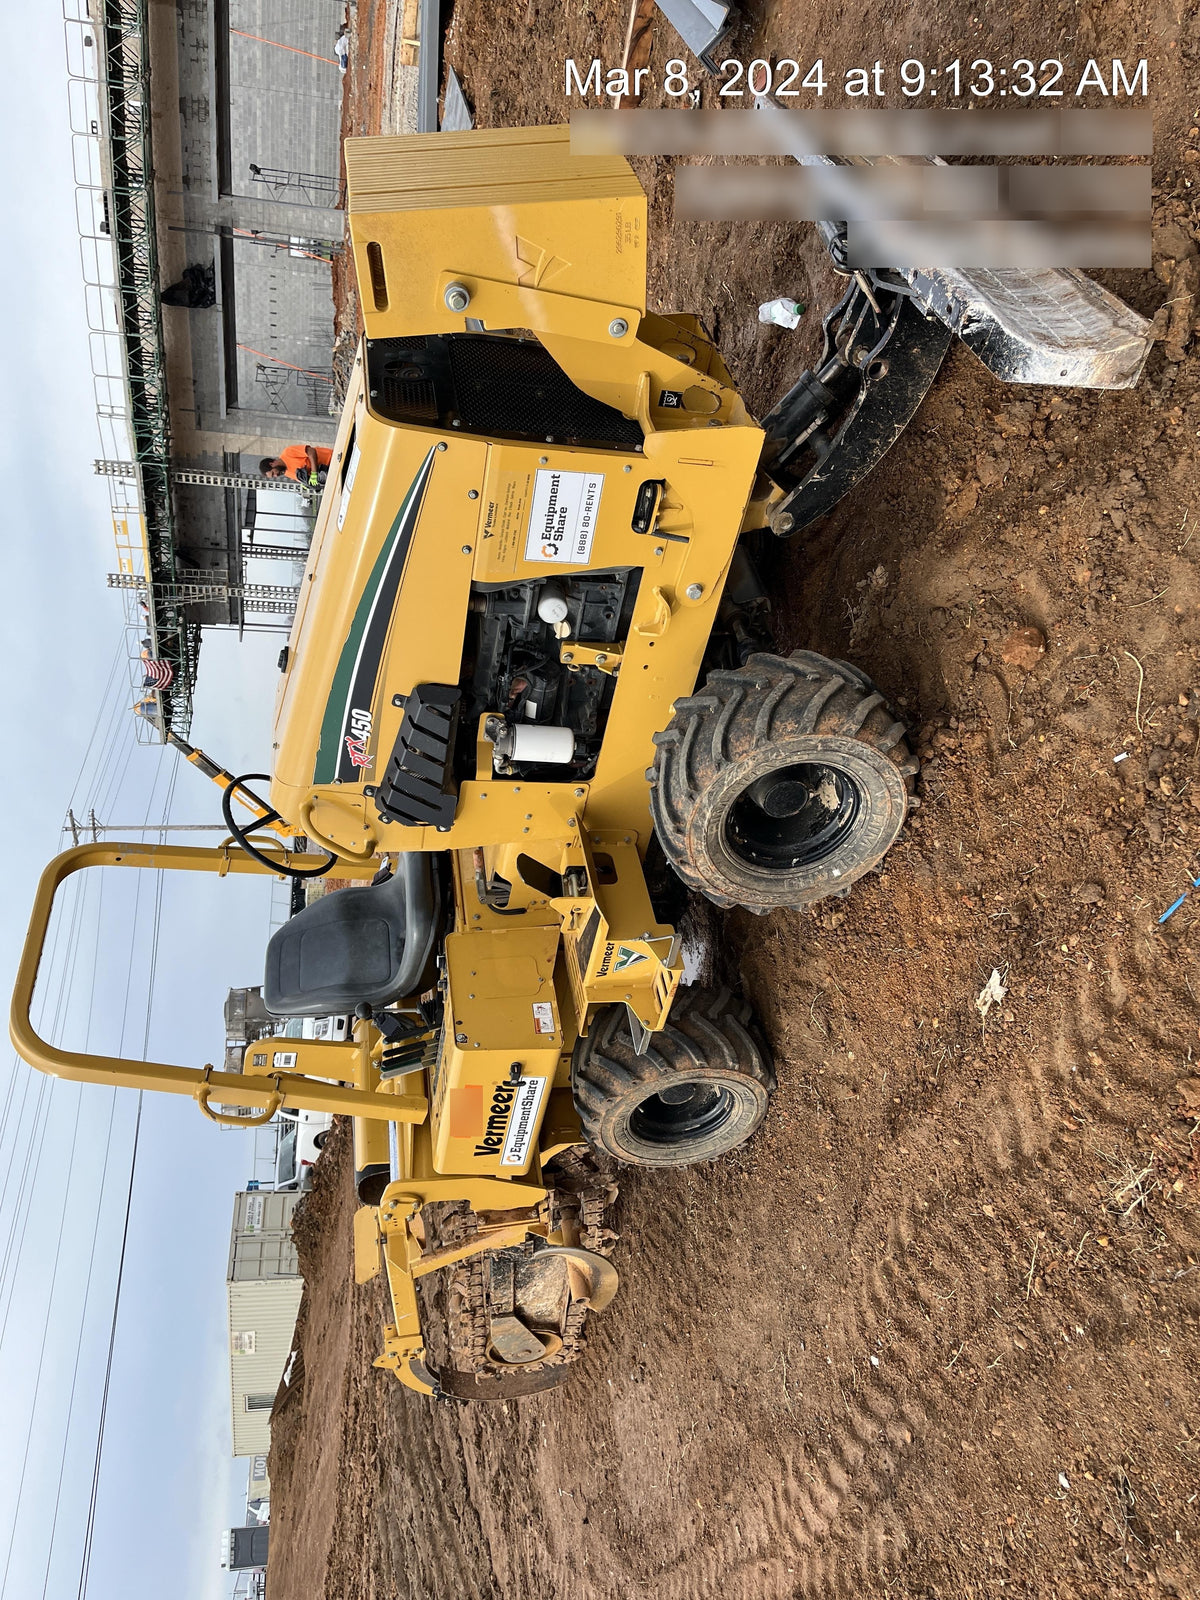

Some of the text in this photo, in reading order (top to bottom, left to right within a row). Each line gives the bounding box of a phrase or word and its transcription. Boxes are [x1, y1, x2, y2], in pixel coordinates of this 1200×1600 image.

[484, 501, 495, 529] Vermeer
[540, 473, 561, 542] Equipment
[553, 506, 568, 542] Share
[576, 482, 597, 556] (888) 80-RENTS
[595, 941, 616, 979] Vermeer
[473, 1085, 515, 1157] Vermeer
[509, 1079, 539, 1154] EquipmentShare
